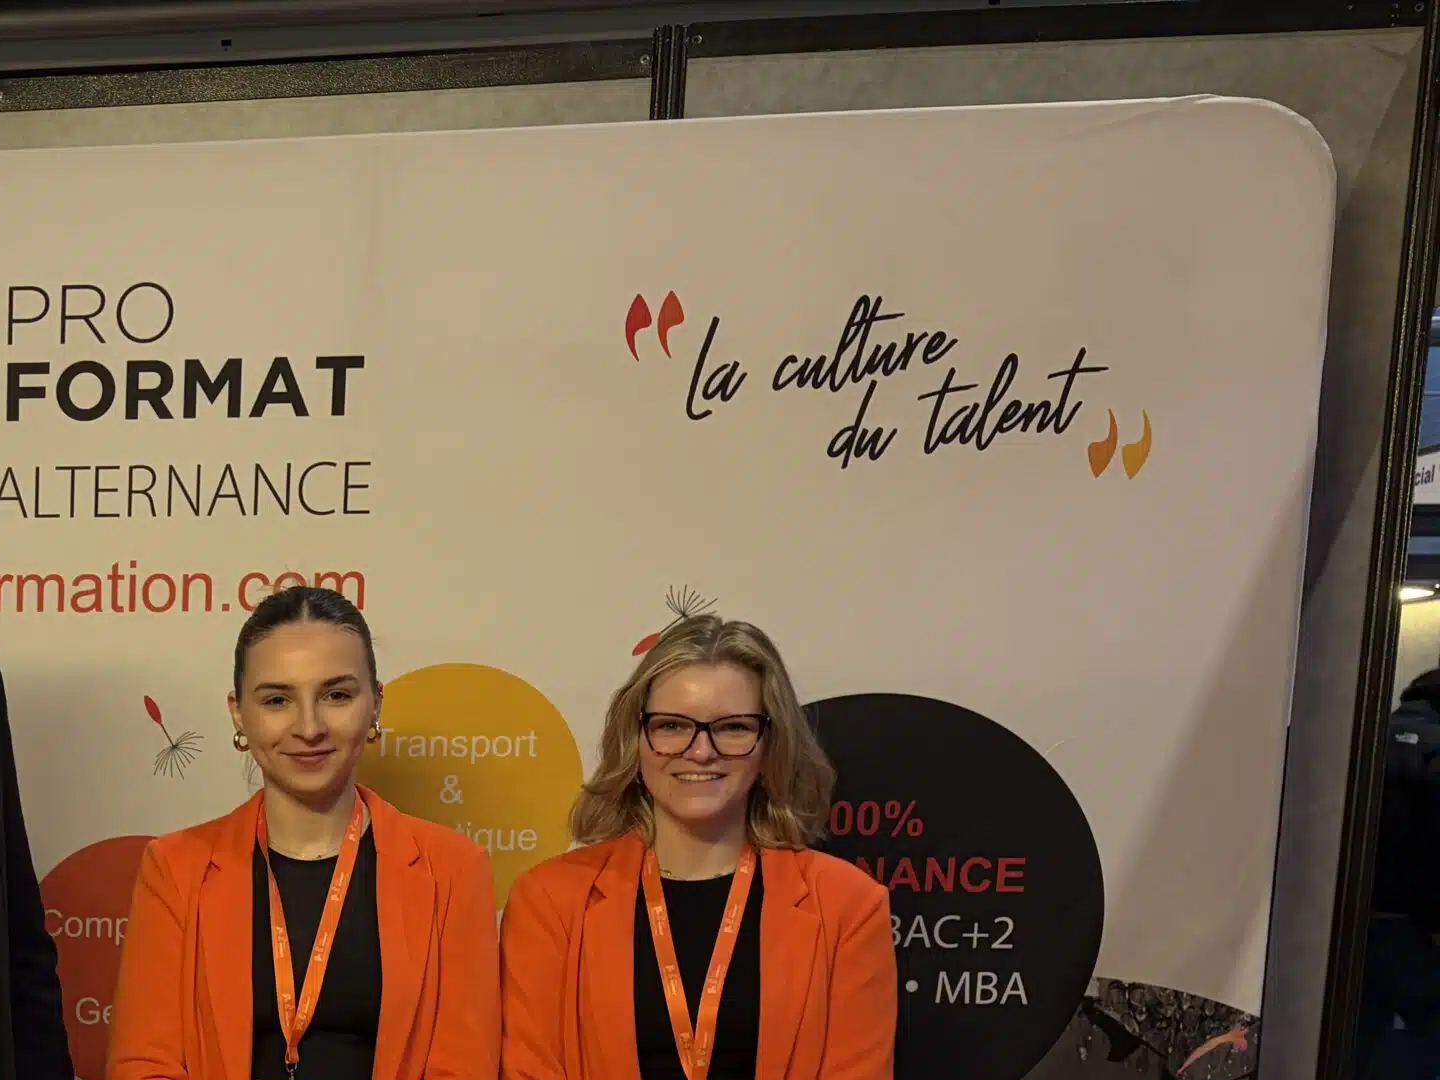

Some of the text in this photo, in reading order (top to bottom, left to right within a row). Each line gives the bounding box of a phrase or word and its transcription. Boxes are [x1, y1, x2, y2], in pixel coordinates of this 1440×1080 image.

[7, 282, 174, 345] PRO
[686, 294, 959, 421] La culture
[6, 355, 366, 422] FORMAT
[826, 348, 1110, 470] du talent
[377, 728, 537, 760] Transport
[439, 775, 464, 804] &
[830, 800, 924, 837] 00%
[935, 972, 1029, 1005] MBA
